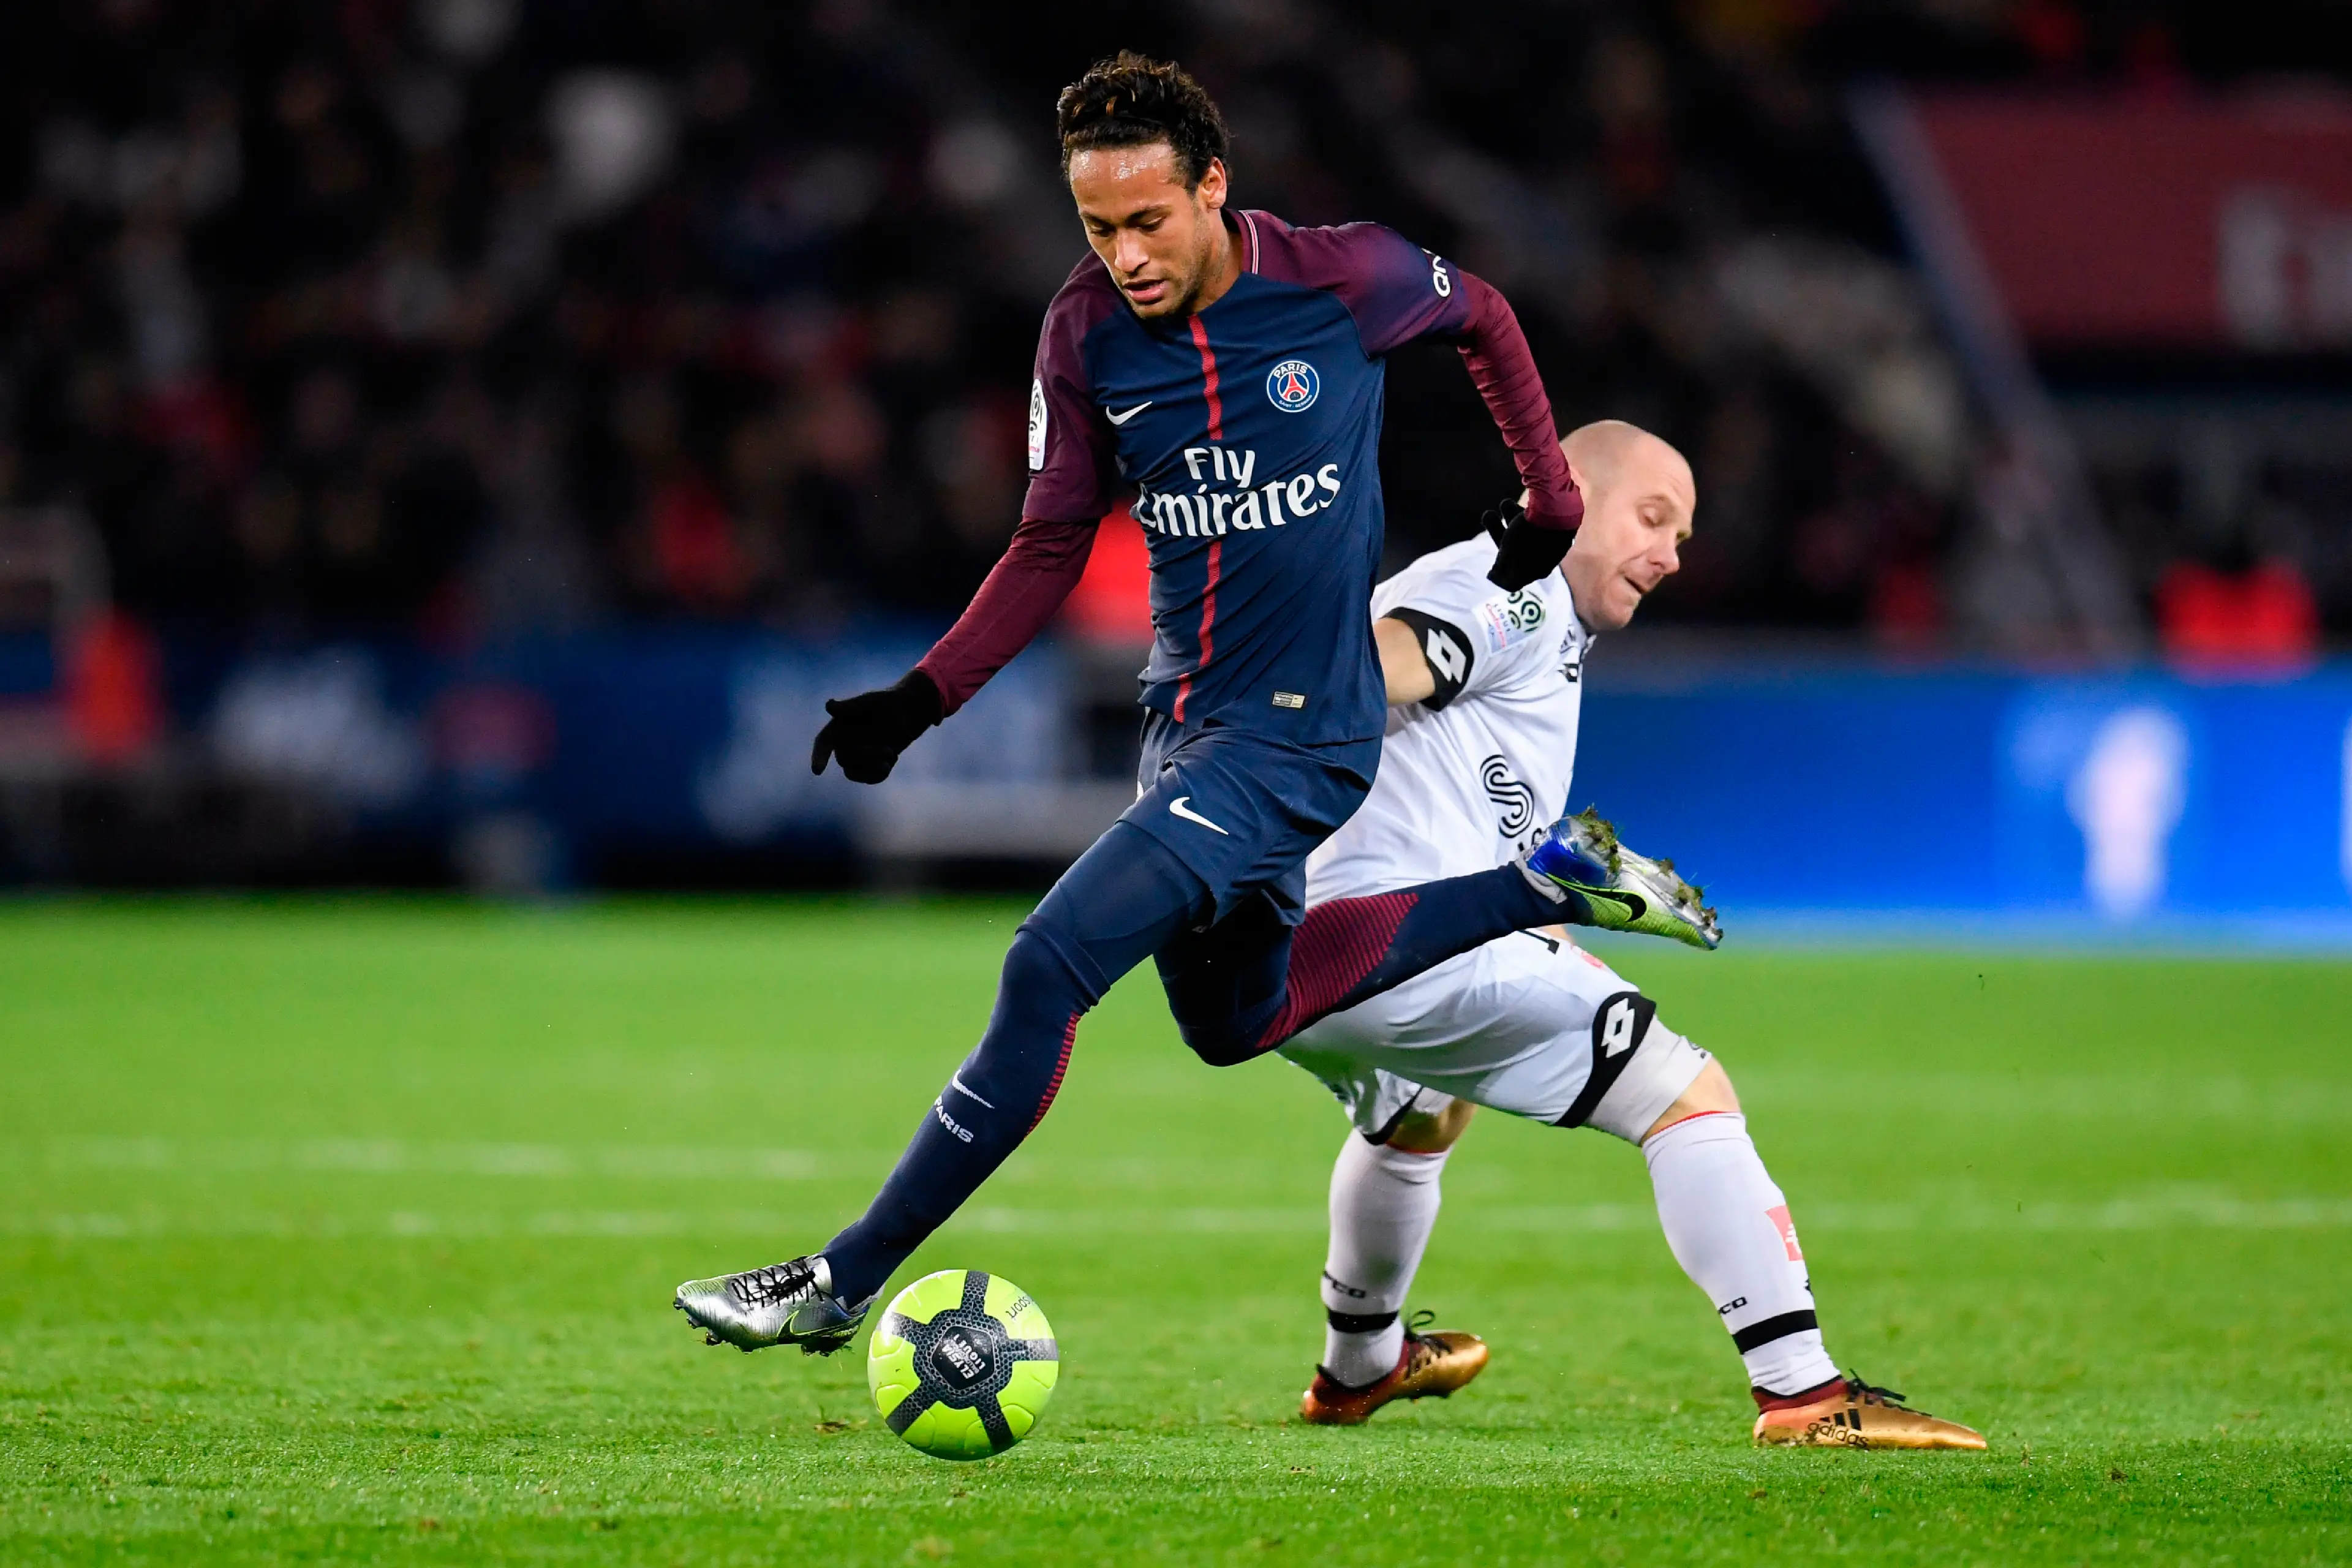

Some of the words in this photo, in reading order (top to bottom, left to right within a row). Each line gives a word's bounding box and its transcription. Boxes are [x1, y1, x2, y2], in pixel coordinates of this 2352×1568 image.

[1273, 363, 1308, 379] PARIS
[1185, 446, 1256, 489] Fly
[1137, 463, 1341, 537] Emirates
[934, 1095, 974, 1144] PARIS
[1807, 1422, 1869, 1449] adidas
